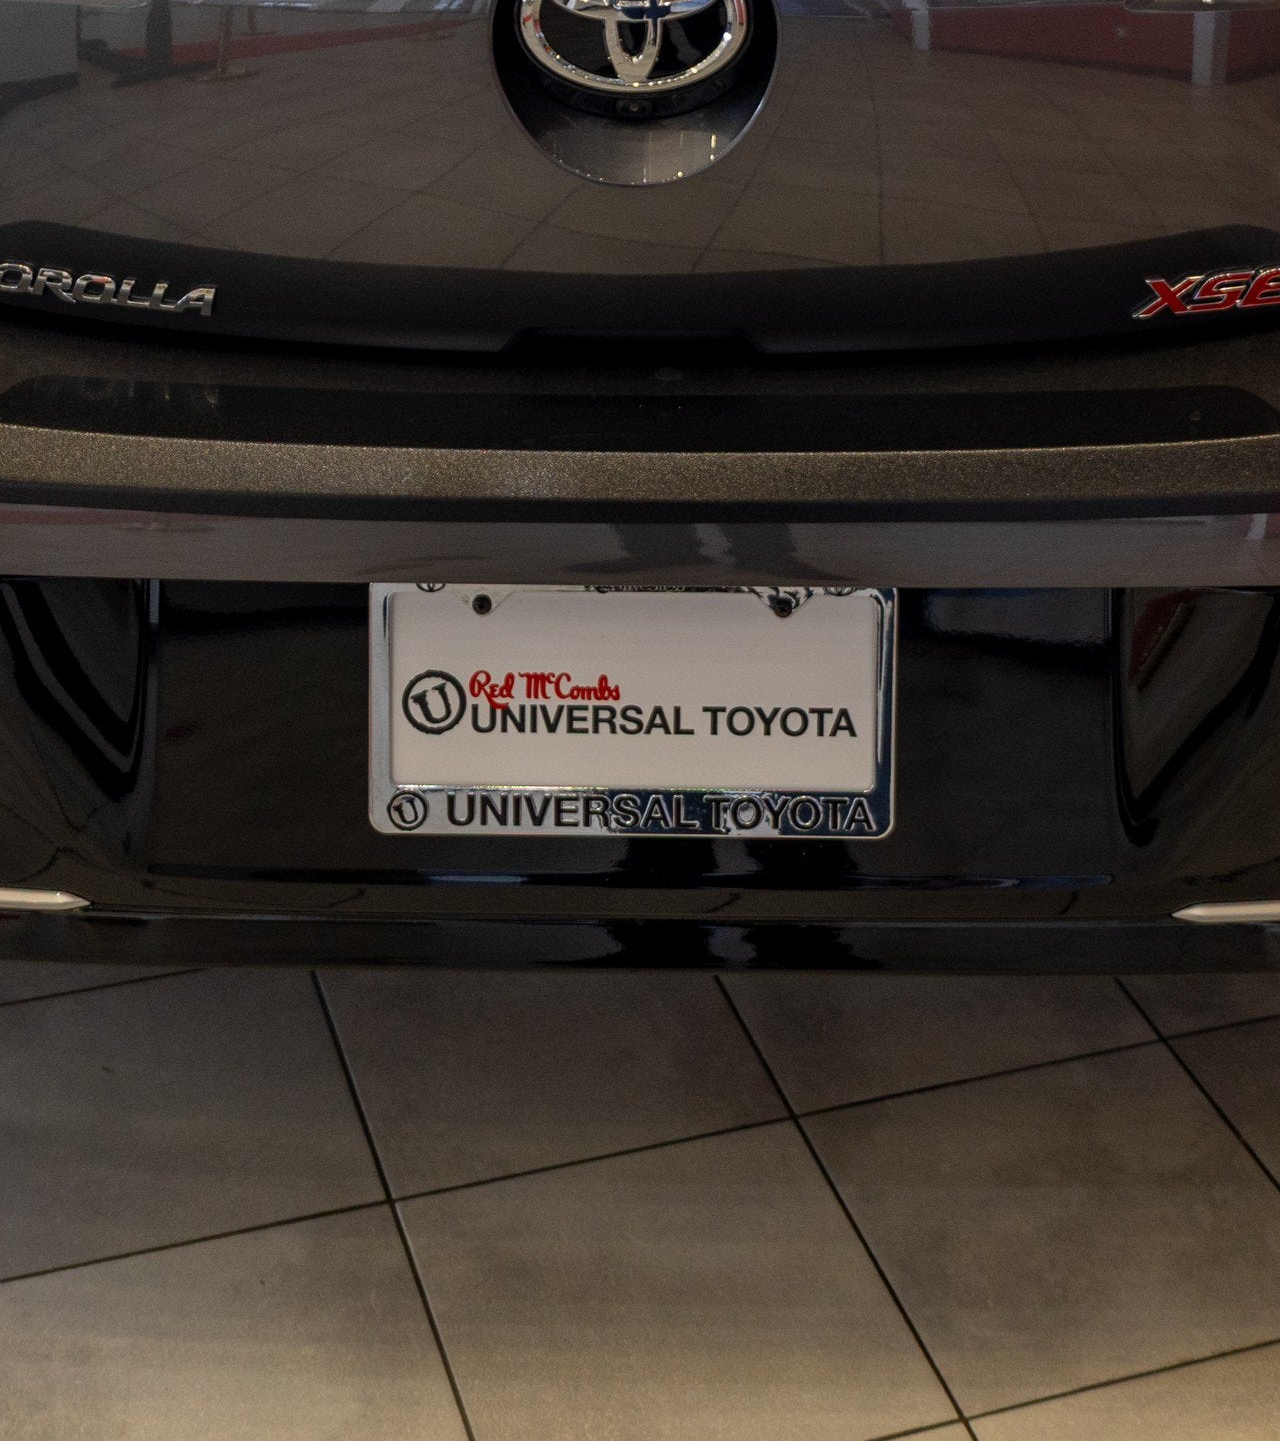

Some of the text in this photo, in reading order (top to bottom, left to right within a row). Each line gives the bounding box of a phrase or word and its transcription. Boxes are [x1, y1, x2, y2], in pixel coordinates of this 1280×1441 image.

[469, 669, 621, 709] Red McCombs
[471, 703, 858, 738] UNIVERSAL TOYOTA
[446, 790, 877, 832] UNIVERSAL TOYOTA
